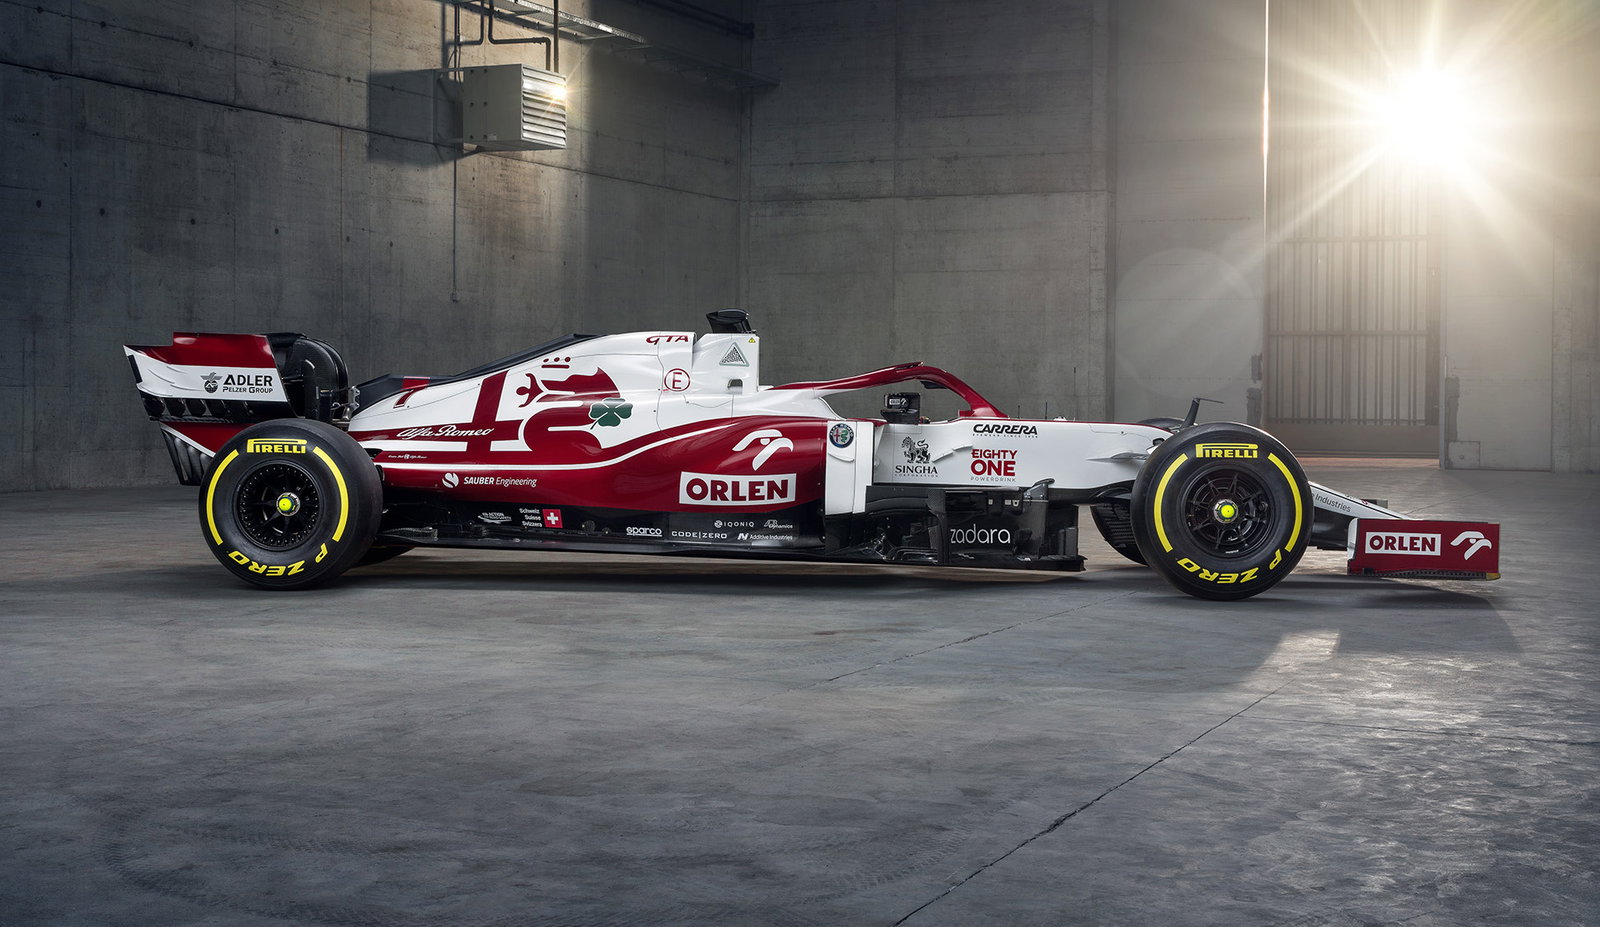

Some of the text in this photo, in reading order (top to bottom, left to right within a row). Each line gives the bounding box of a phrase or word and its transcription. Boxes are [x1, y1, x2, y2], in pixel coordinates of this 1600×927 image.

[646, 335, 689, 345] GTA
[223, 374, 273, 387] ADLER
[672, 371, 682, 389] E
[396, 425, 494, 440] Alfa Romeo
[973, 424, 1038, 435] CARRERA
[246, 438, 307, 454] PIRELLI
[1195, 443, 1259, 458] PIRELLI
[971, 449, 1018, 459] EIGHTY
[895, 465, 938, 475] SINGHA
[970, 460, 1016, 477] ONE
[463, 477, 537, 487] SAUBER Engineering
[686, 478, 789, 501] ORLEN
[1314, 493, 1352, 513] Industries
[626, 526, 663, 537] sparco
[749, 533, 793, 541] Additive Industries
[950, 523, 1011, 544] zadara
[1369, 534, 1437, 553] ORLEN
[227, 542, 329, 576] P ZERO
[1176, 549, 1283, 584] P ZERO
